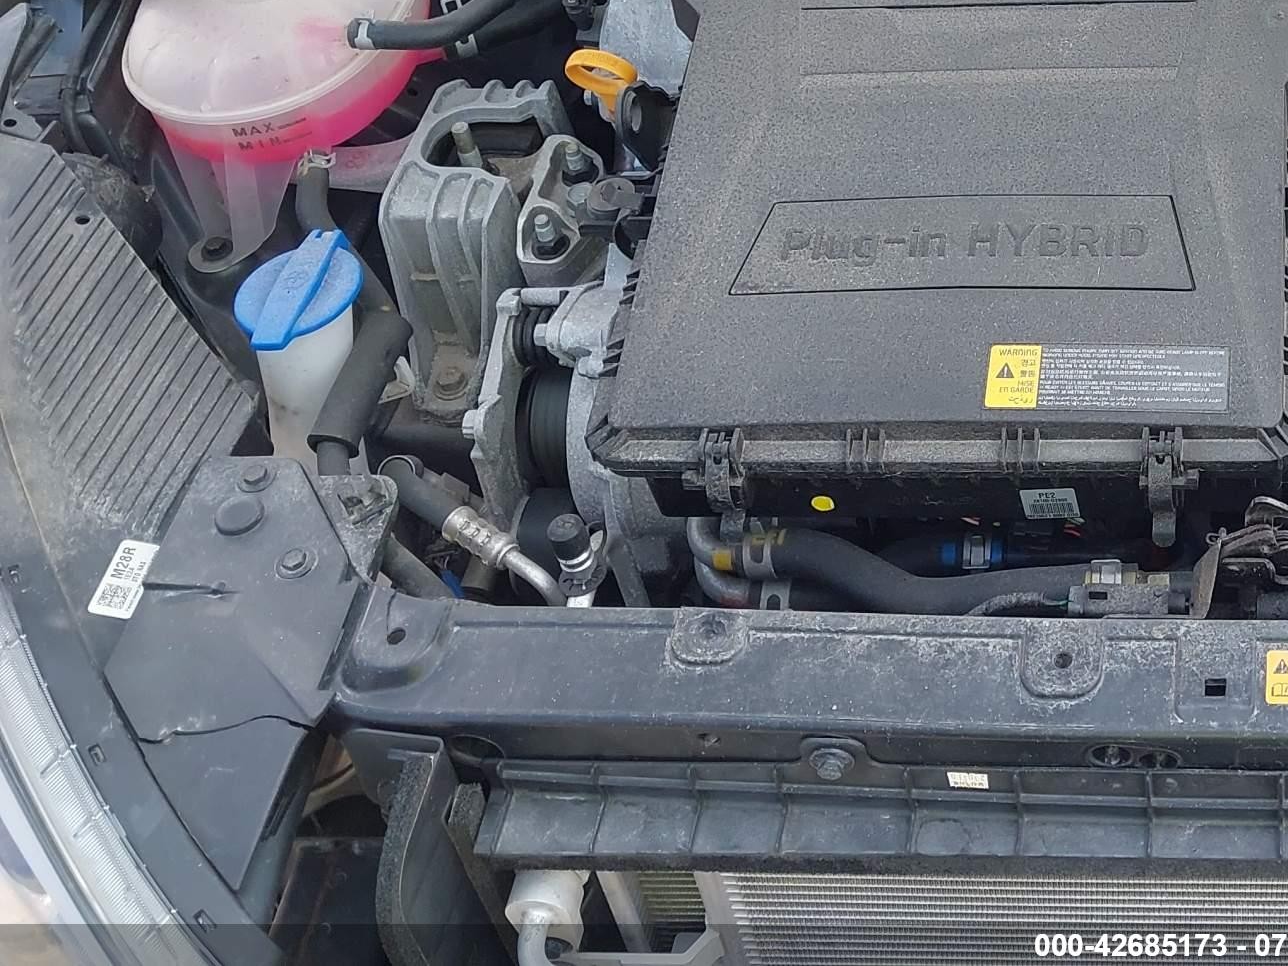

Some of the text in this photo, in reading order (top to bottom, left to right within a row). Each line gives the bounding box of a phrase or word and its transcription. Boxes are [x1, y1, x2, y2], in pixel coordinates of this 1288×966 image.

[231, 121, 275, 137] MAX
[238, 136, 282, 150] MIN
[781, 222, 1151, 268] Plug-in HYBRID
[999, 348, 1038, 356] WARNING
[110, 547, 136, 580] M28R
